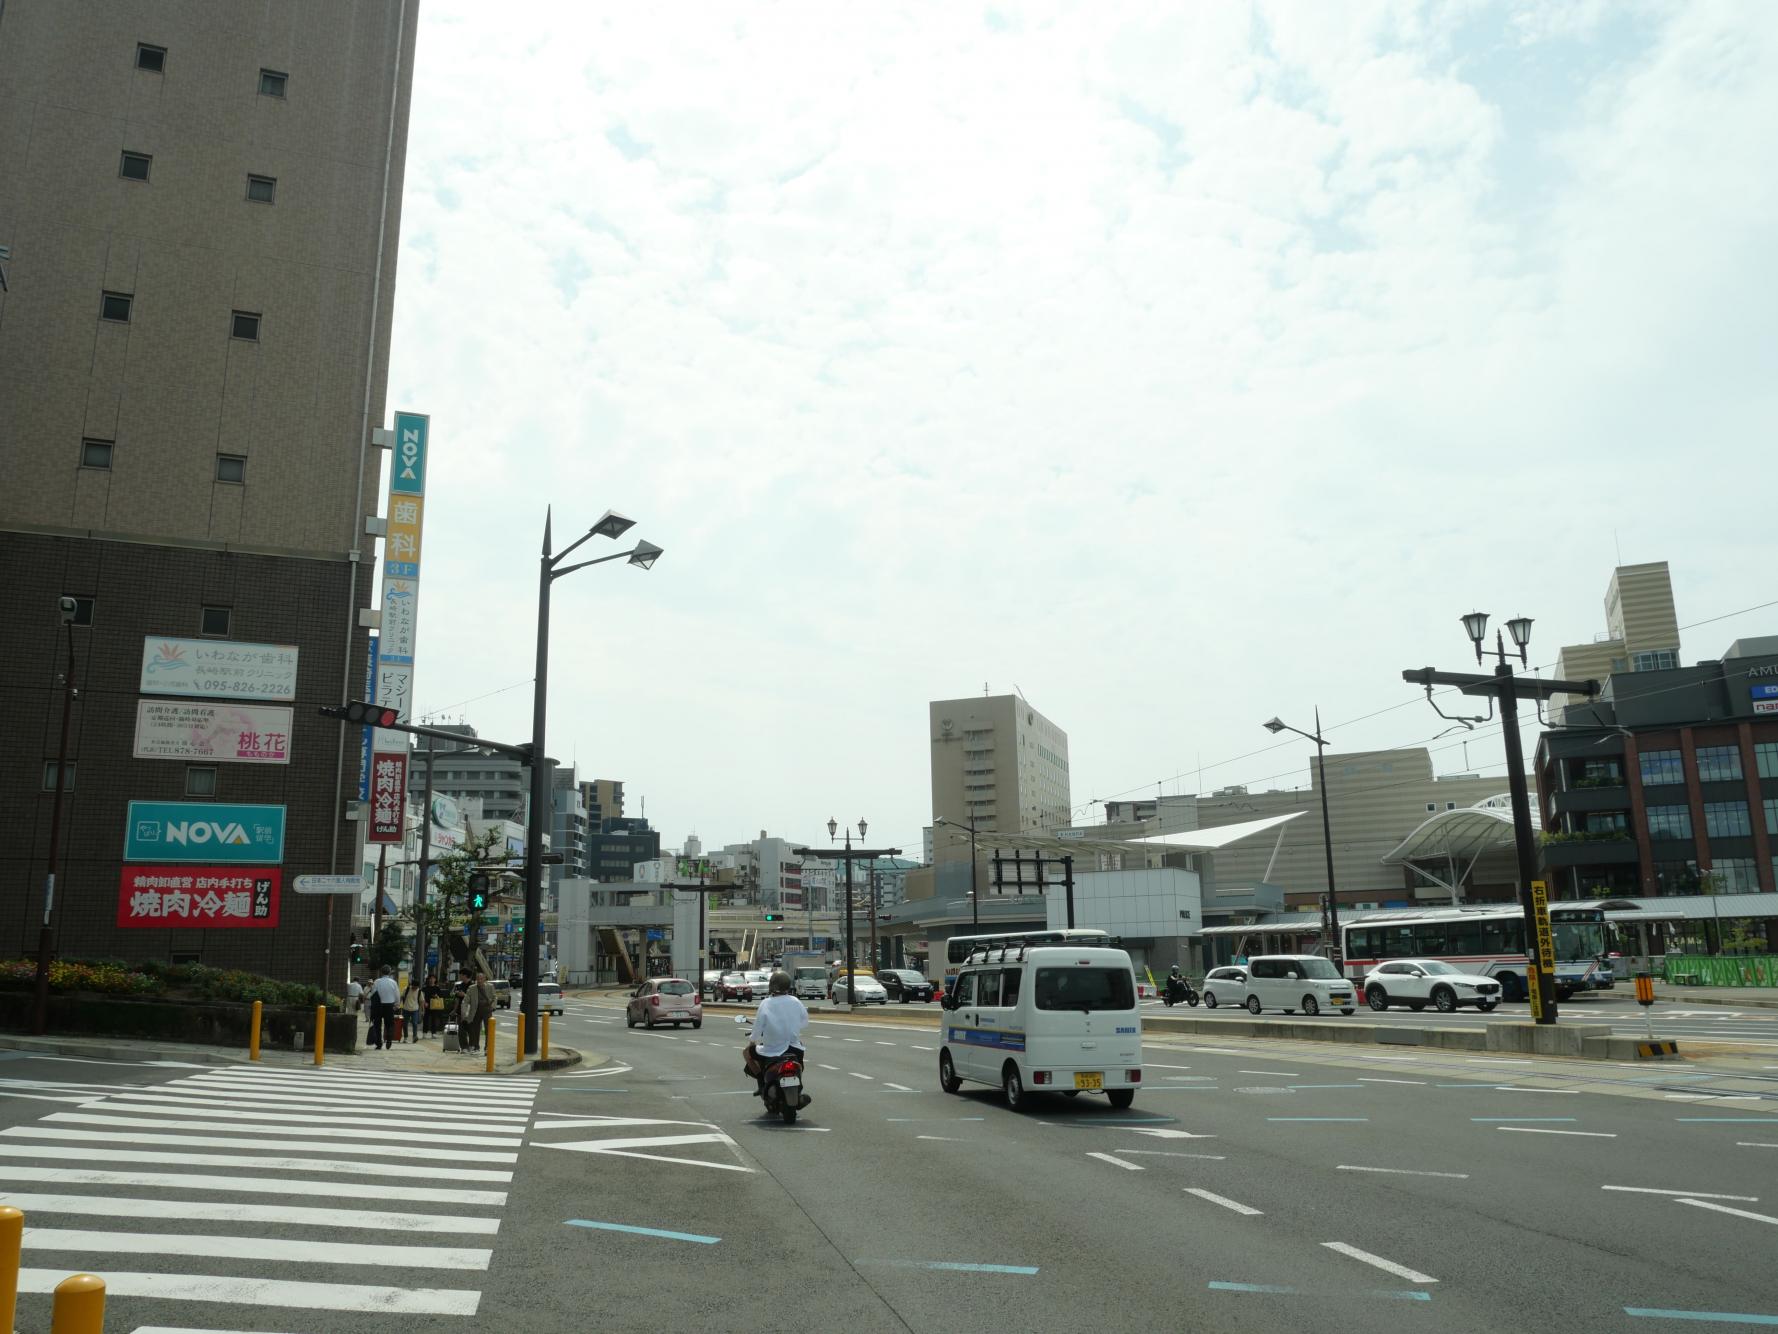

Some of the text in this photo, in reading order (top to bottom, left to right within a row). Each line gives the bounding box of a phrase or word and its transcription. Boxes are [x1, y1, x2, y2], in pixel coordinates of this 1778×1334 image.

[399, 429, 419, 480] NOVA
[391, 501, 418, 558] 歯科
[195, 648, 294, 665] いわなが歯科
[204, 679, 291, 694] 095-826-2226
[238, 731, 286, 751] 桃花
[375, 760, 395, 824] 焼肉冷麺
[166, 821, 251, 846] NOVA
[134, 876, 253, 889] 精肉卸直営 店内手打ち
[130, 889, 251, 917] 焼肉冷麺
[254, 881, 271, 917] げん助
